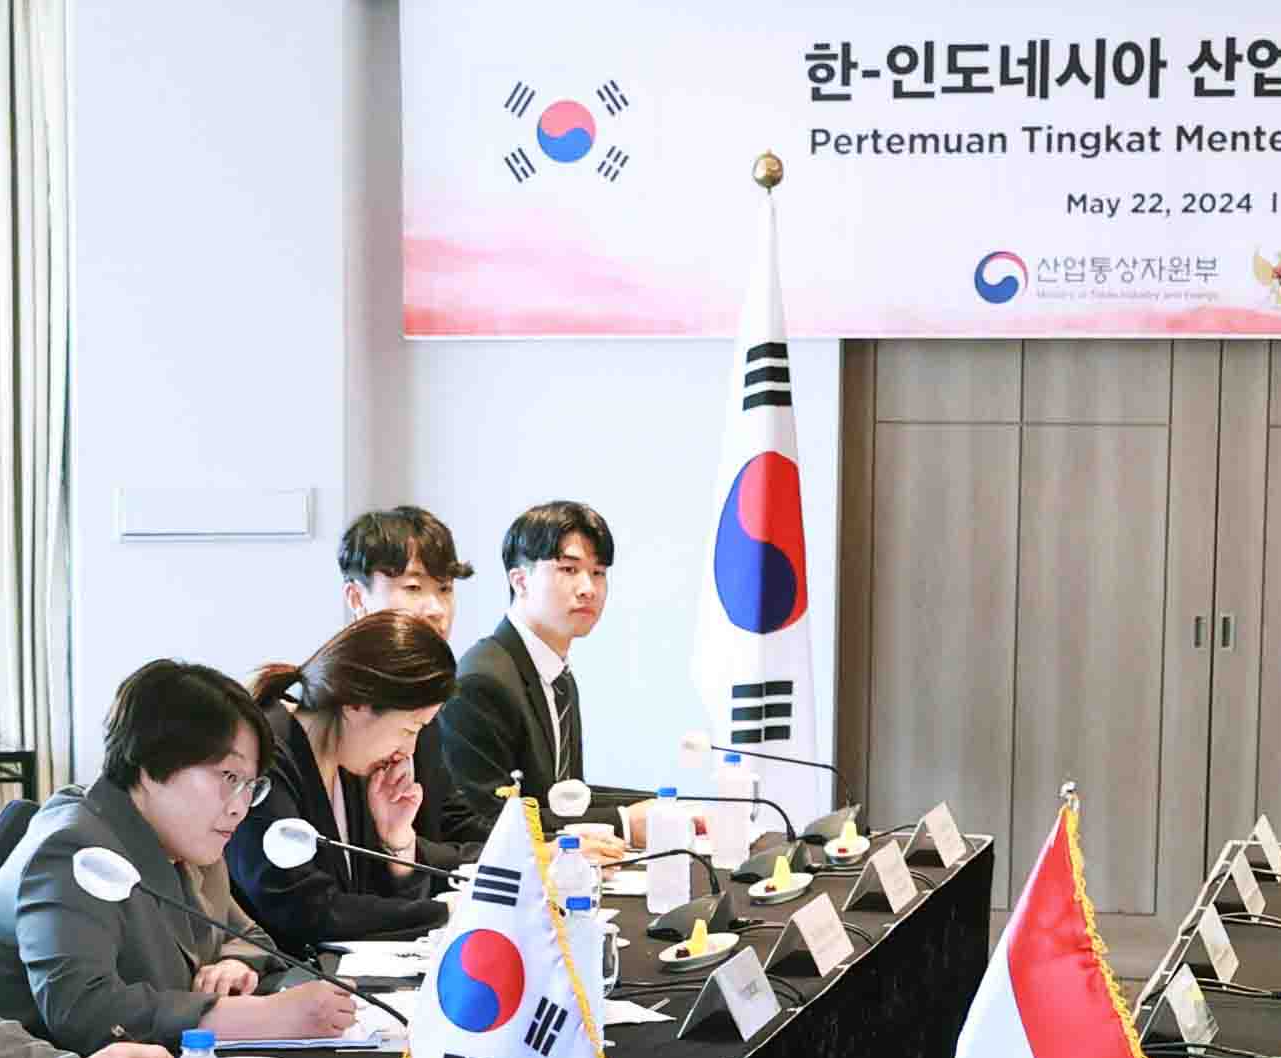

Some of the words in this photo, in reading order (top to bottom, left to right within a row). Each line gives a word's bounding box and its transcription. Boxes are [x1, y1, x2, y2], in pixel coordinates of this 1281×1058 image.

[804, 37, 1168, 102] 한-인도네시아
[810, 127, 1008, 155] Pertemuan
[1021, 124, 1162, 159] Tingkat
[1066, 193, 1122, 219] May
[1130, 192, 1171, 217] 22,
[1181, 192, 1253, 214] 2024
[1037, 256, 1219, 285] 산업통상자원부
